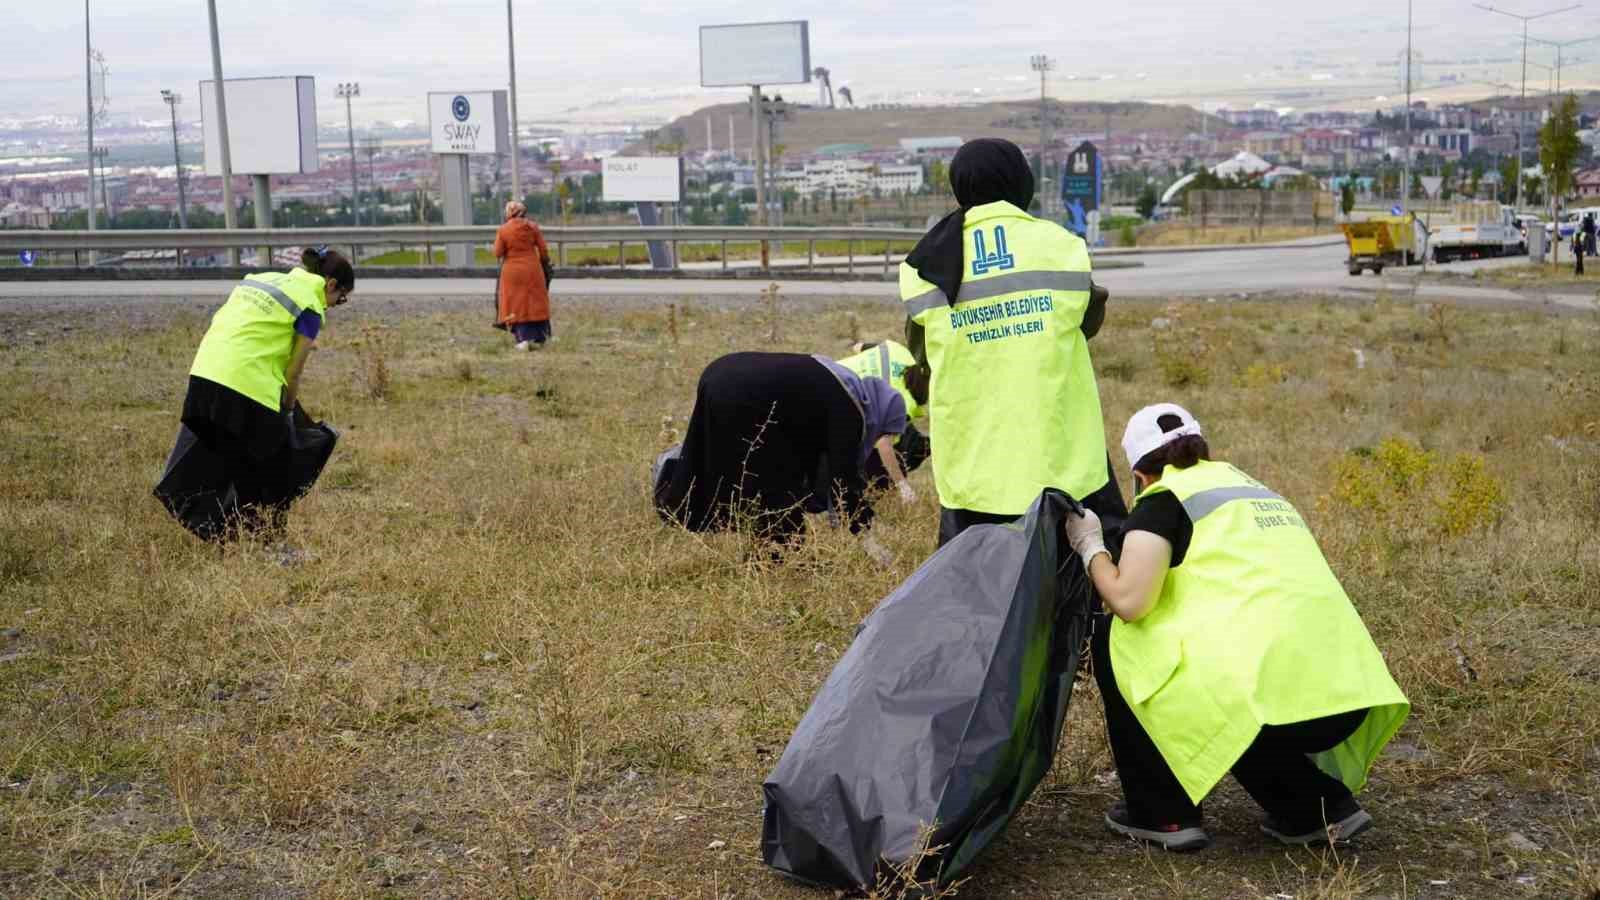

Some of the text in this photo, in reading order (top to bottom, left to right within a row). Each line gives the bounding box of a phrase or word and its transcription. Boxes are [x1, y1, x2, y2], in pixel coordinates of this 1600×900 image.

[443, 124, 481, 141] SWAY
[950, 291, 1053, 328] BÜYÜKŞEHİR BELEDİYESİ
[966, 318, 1044, 344] TEMİZLİK İŞLERİ
